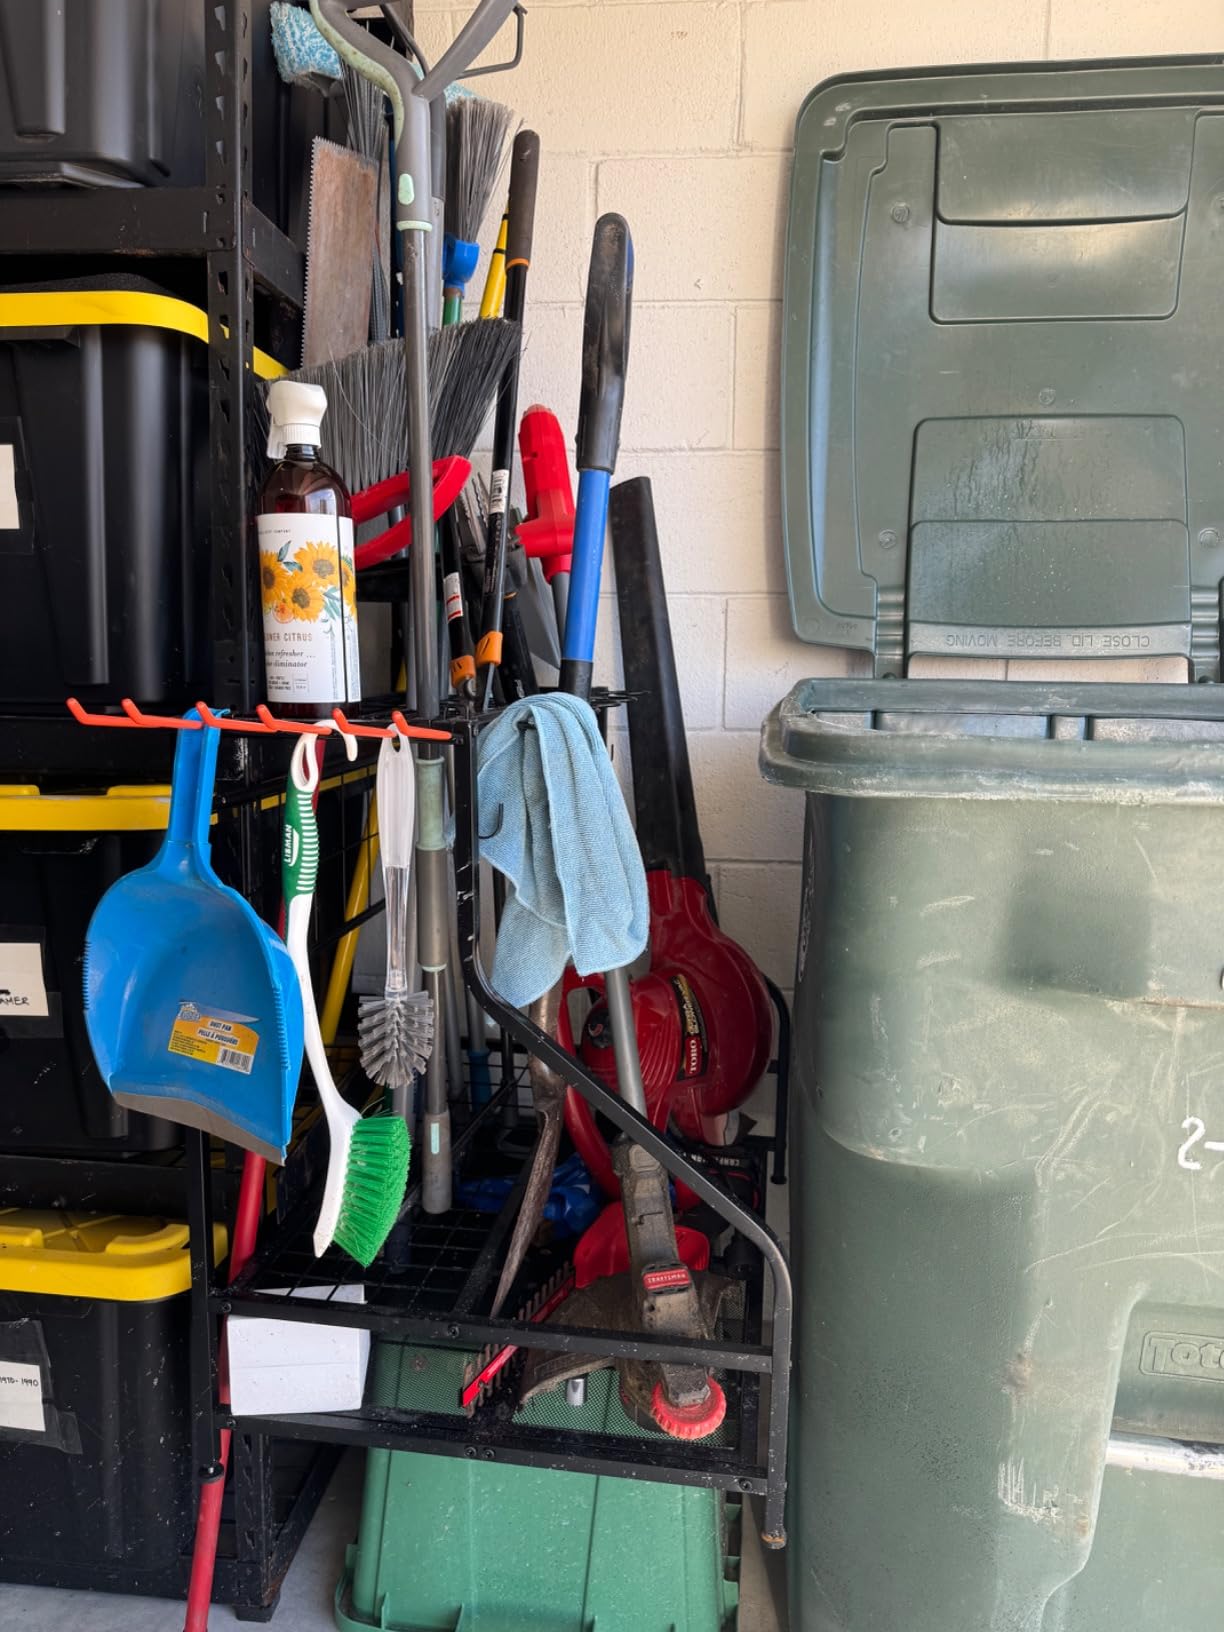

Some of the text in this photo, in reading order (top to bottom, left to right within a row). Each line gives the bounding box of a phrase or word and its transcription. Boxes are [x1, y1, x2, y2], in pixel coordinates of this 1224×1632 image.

[284, 632, 312, 642] CITRUS
[945, 633, 1150, 648] CLOSE LID BEFORE MOVING
[284, 824, 293, 864] LIBMAN
[689, 1039, 698, 1073] TORO
